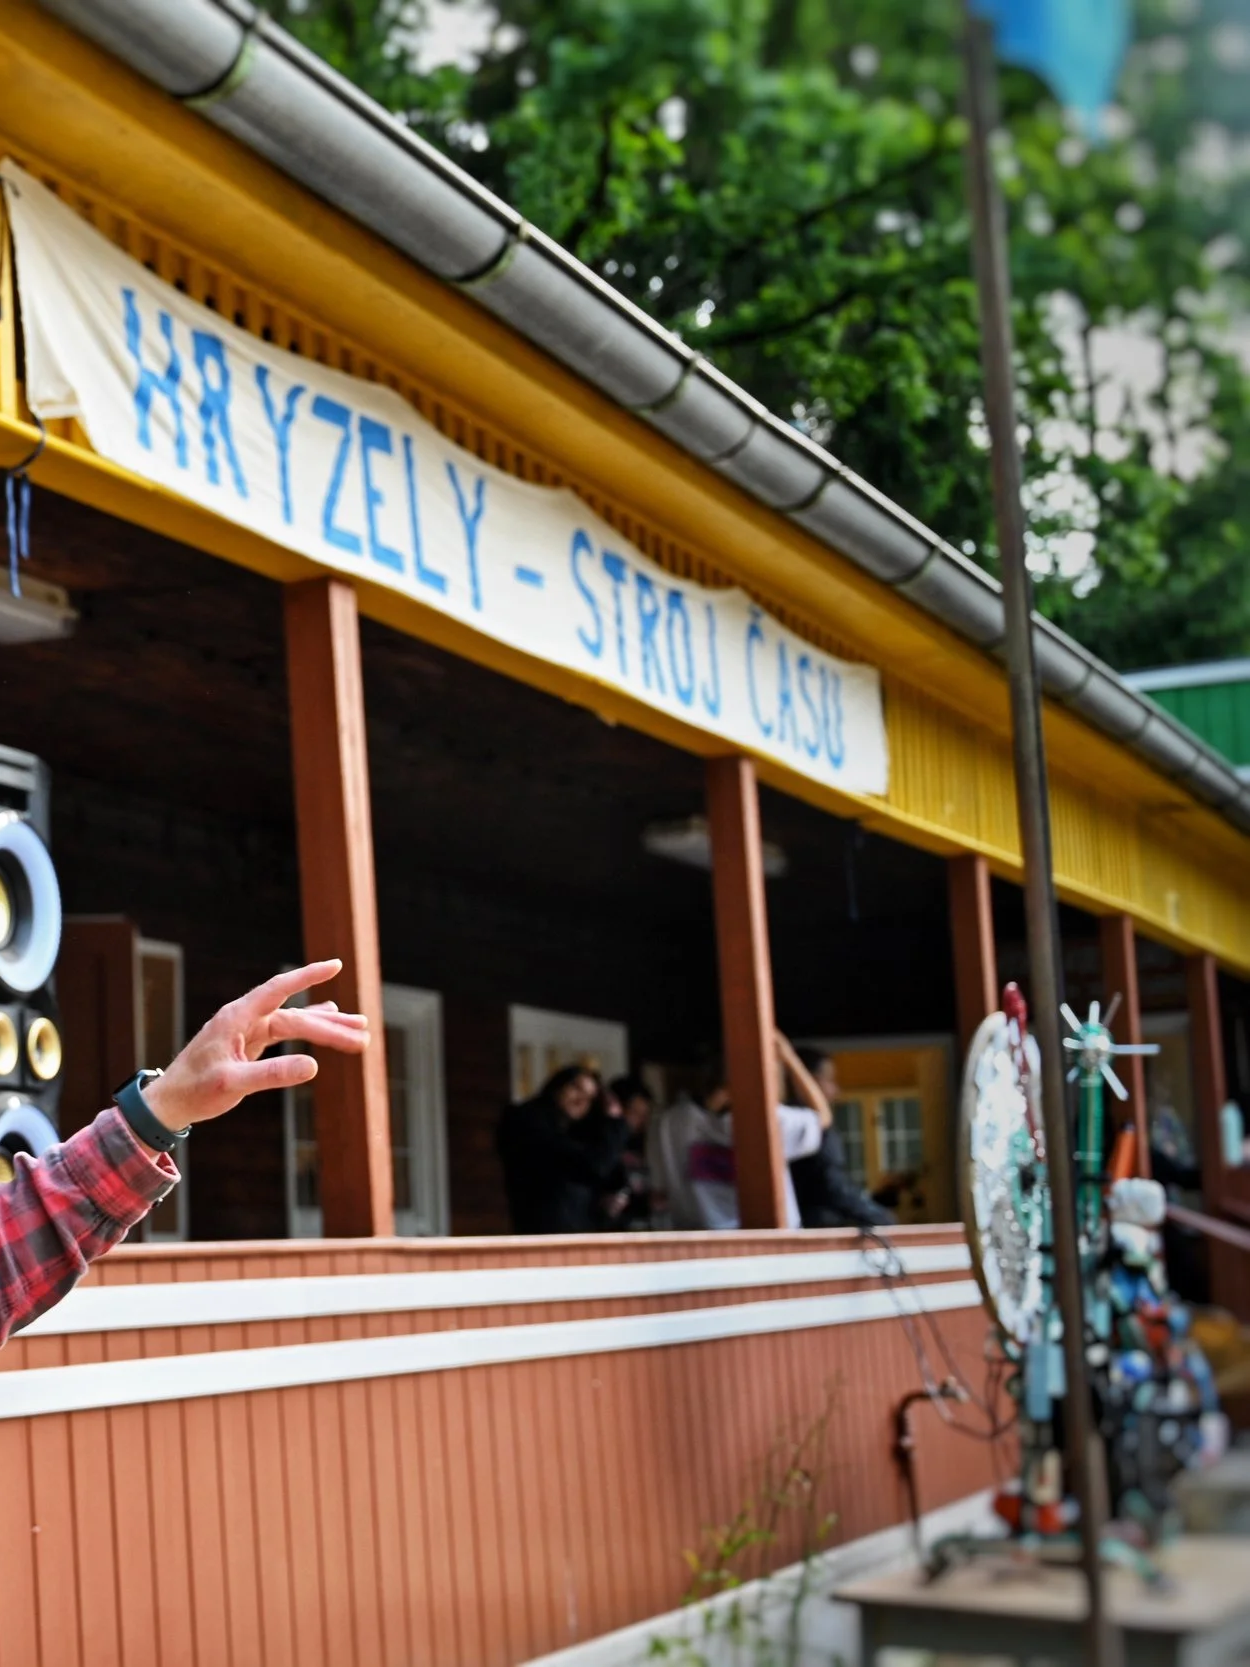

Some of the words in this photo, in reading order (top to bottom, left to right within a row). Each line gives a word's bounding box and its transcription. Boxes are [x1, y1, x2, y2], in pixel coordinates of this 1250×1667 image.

[121, 286, 486, 612] HRYZELY
[571, 528, 720, 718] STROJ
[747, 604, 844, 770] ČASU
